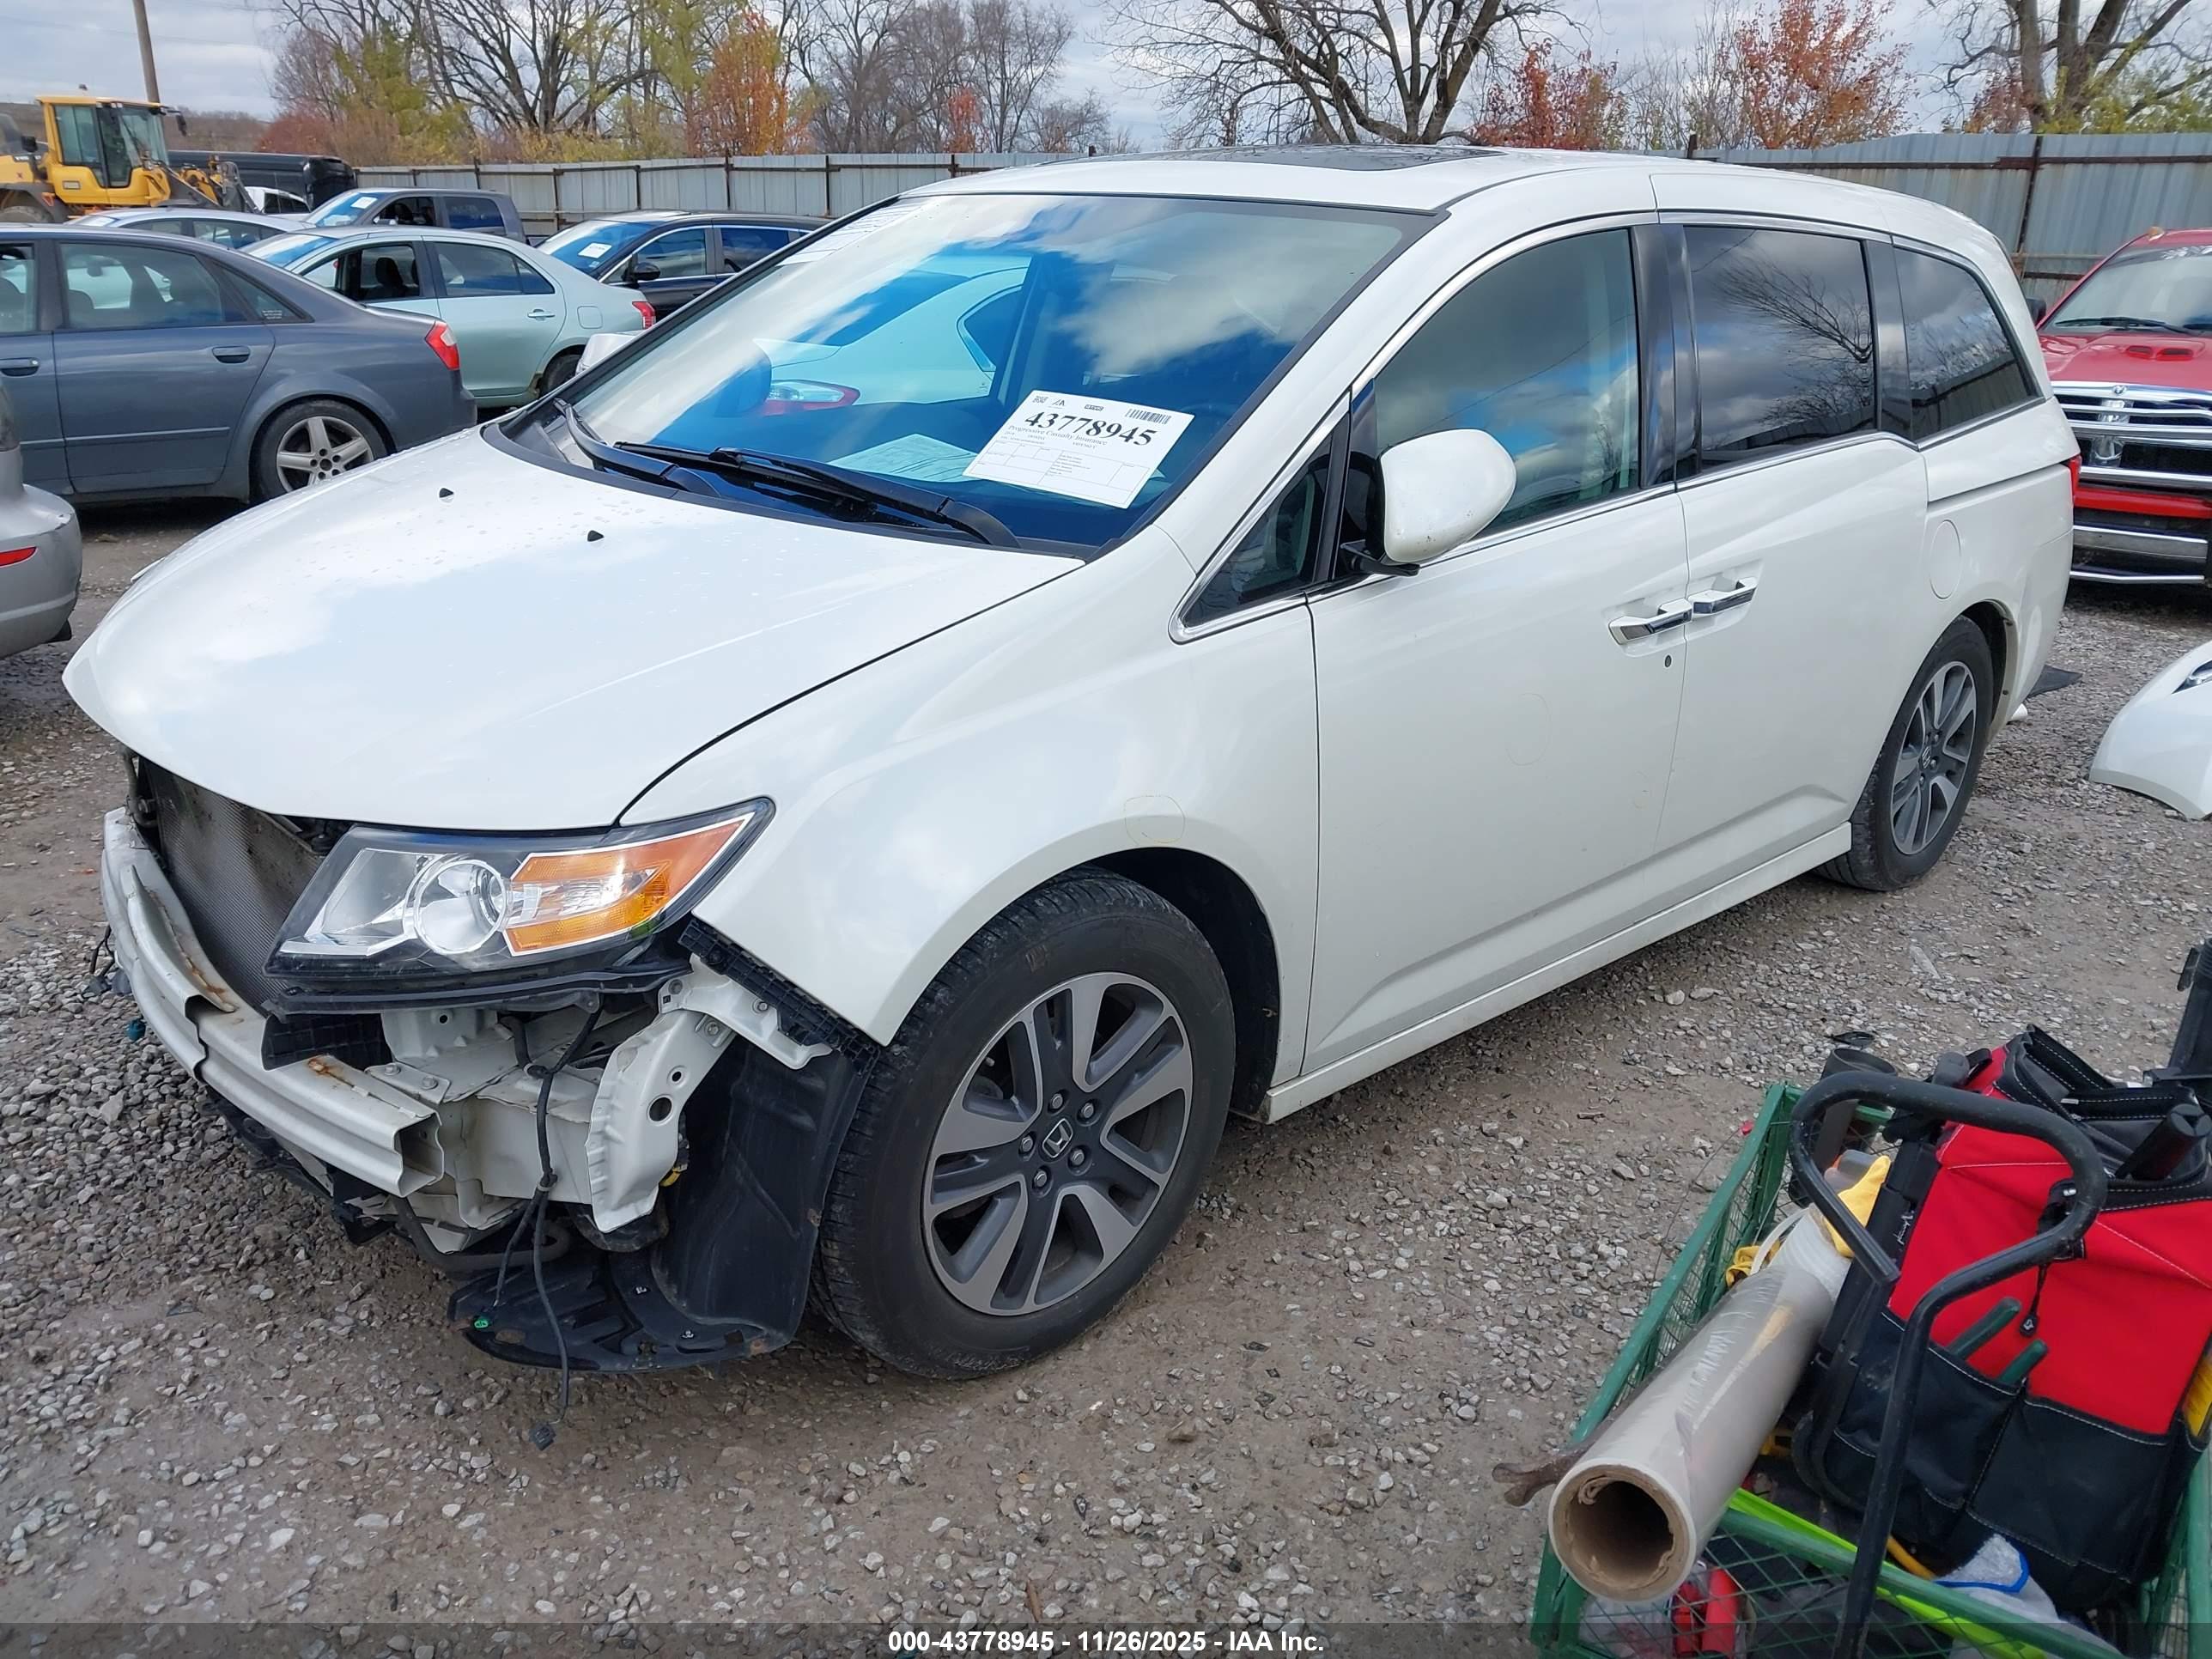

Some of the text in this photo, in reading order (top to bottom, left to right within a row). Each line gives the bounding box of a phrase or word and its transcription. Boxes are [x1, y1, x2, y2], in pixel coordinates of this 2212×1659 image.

[1024, 411, 1158, 447] 43778945
[1045, 429, 1073, 441] Casualty
[1074, 434, 1108, 446] Insurance
